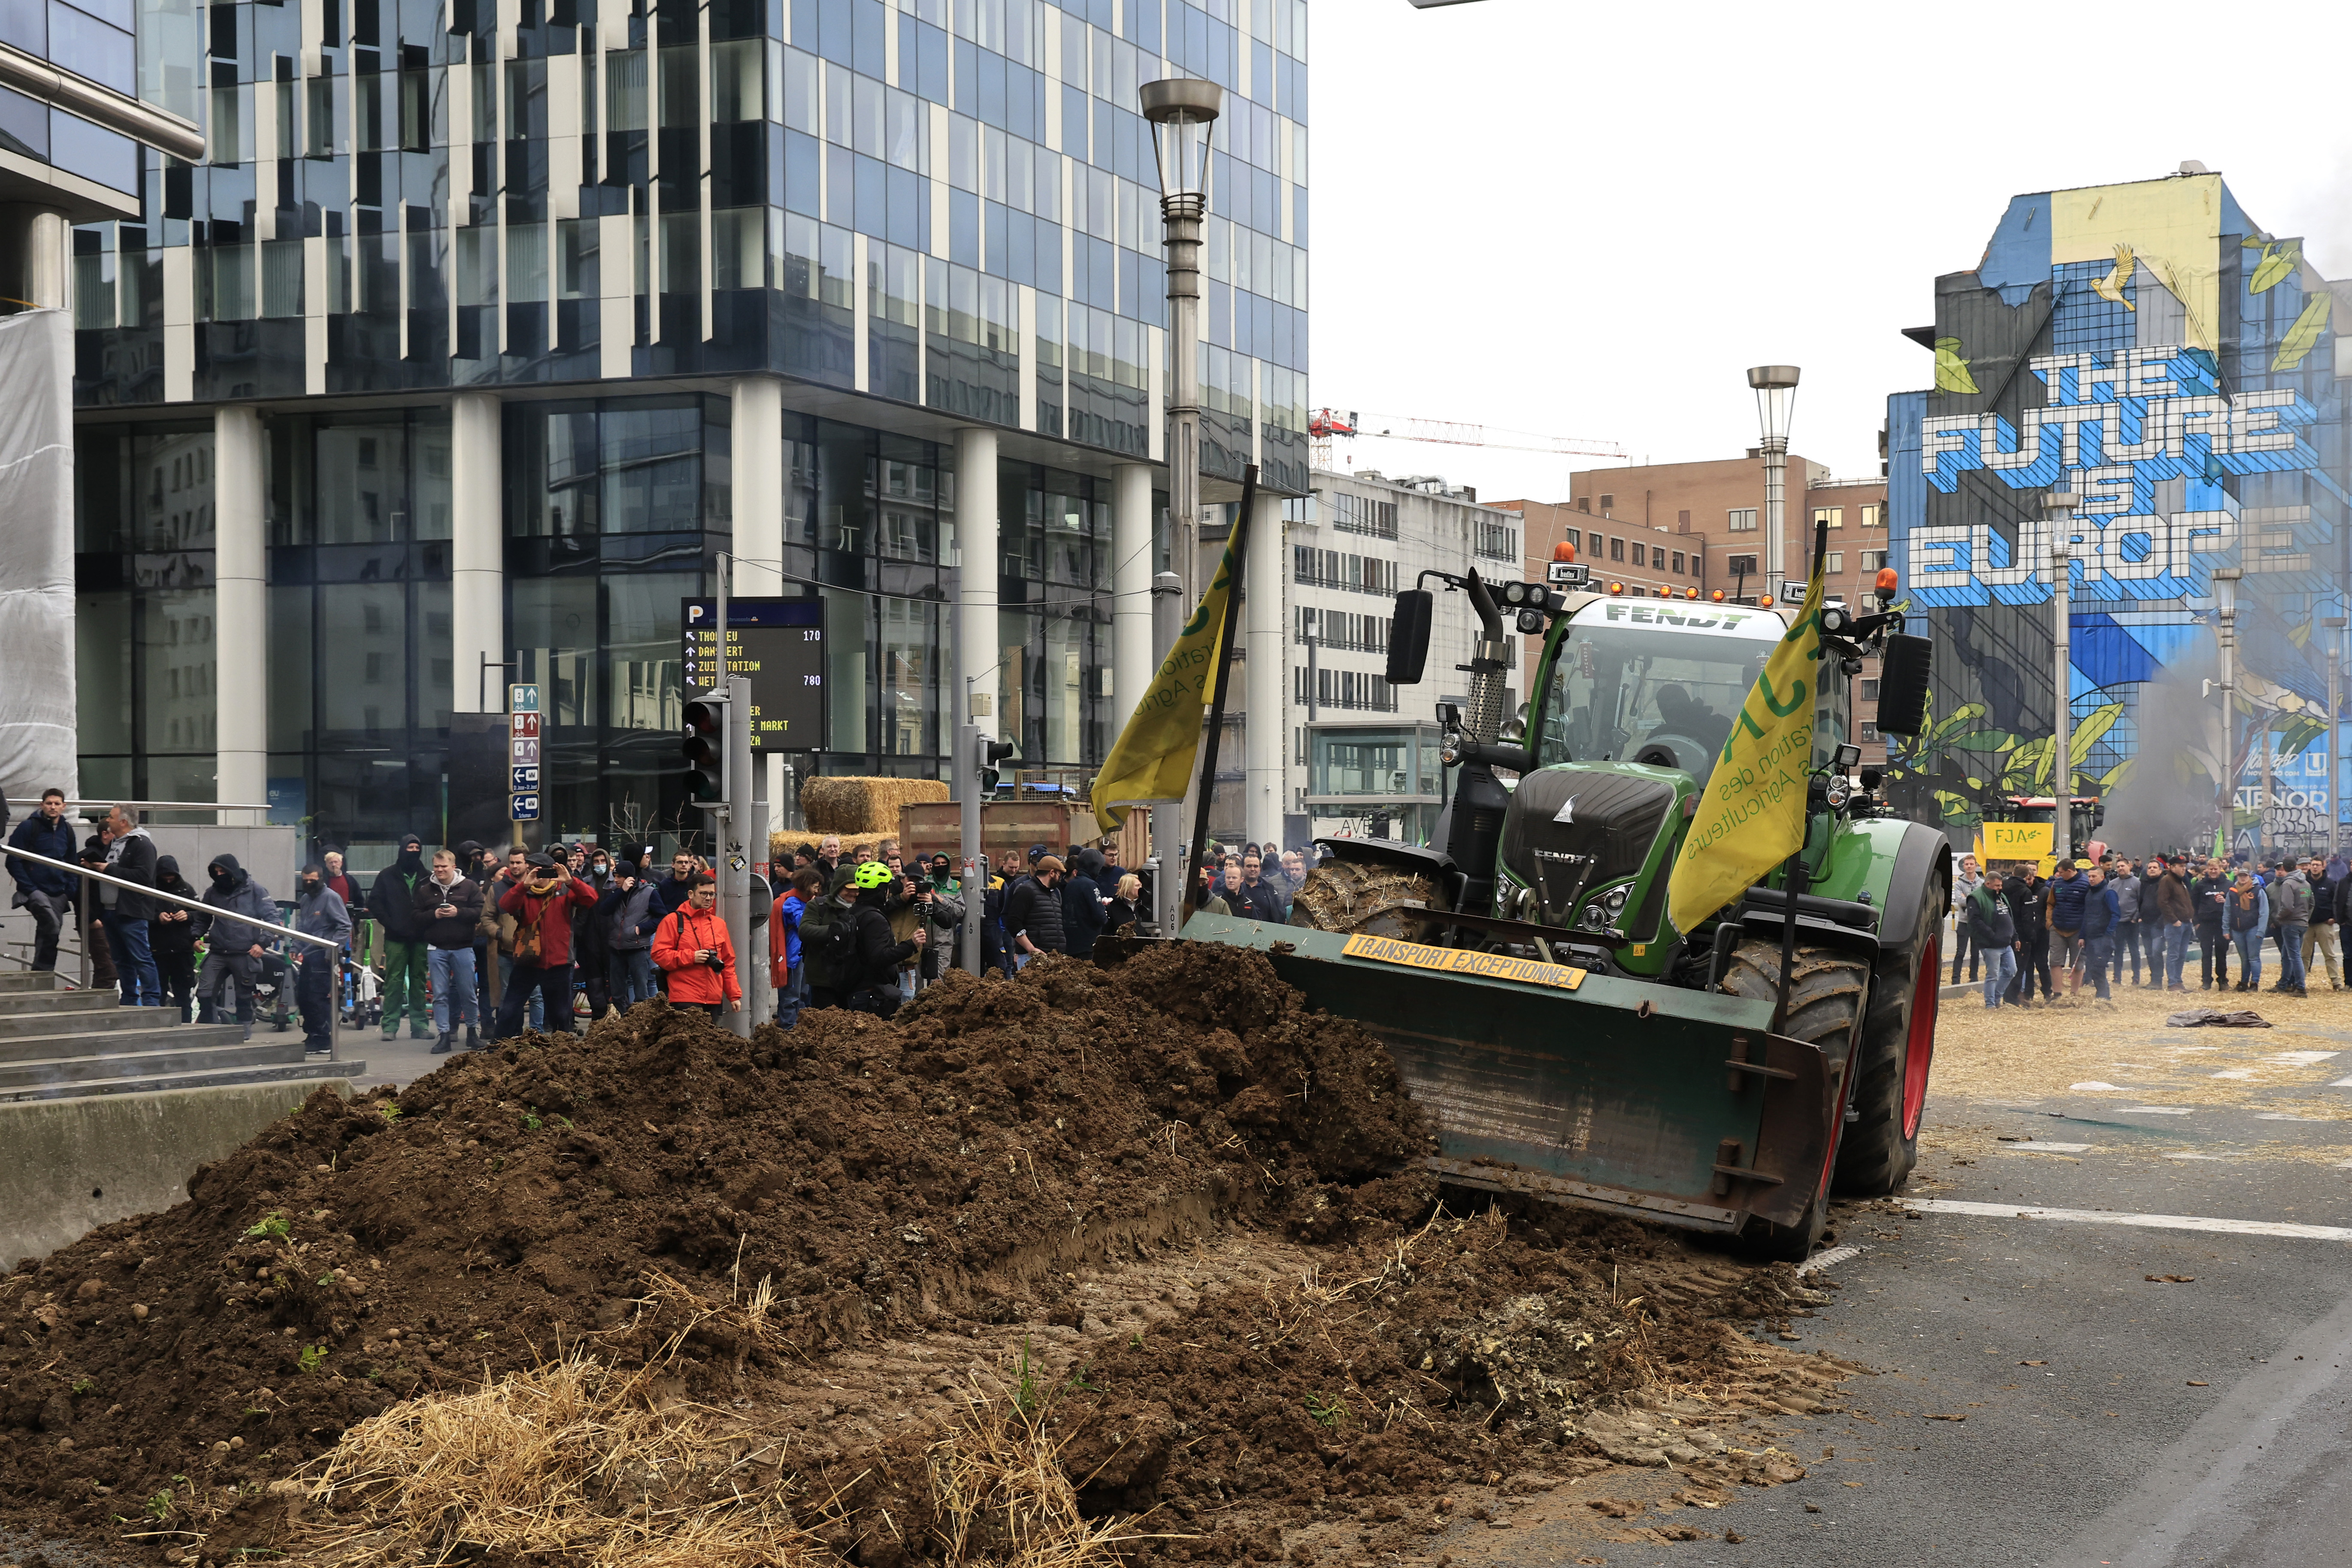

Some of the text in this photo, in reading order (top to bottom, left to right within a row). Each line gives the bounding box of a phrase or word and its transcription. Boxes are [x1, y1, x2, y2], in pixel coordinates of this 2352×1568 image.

[2029, 345, 2186, 405] THE
[1922, 387, 2305, 481] FUTURE
[2070, 464, 2141, 516] IS
[1909, 505, 2319, 594] EUROPE
[1560, 569, 1574, 578] hadley
[1606, 604, 1752, 630] FENDT
[803, 630, 820, 641] 170
[698, 646, 743, 657] DANERT
[698, 661, 760, 672] ZUITATION
[699, 675, 820, 687] WET 780
[761, 720, 788, 731] MARKT
[1996, 829, 2027, 843] FJA
[1535, 850, 1586, 865] FENDT
[1351, 937, 1576, 986] TRANSPORT EXCEPTIONNEL
